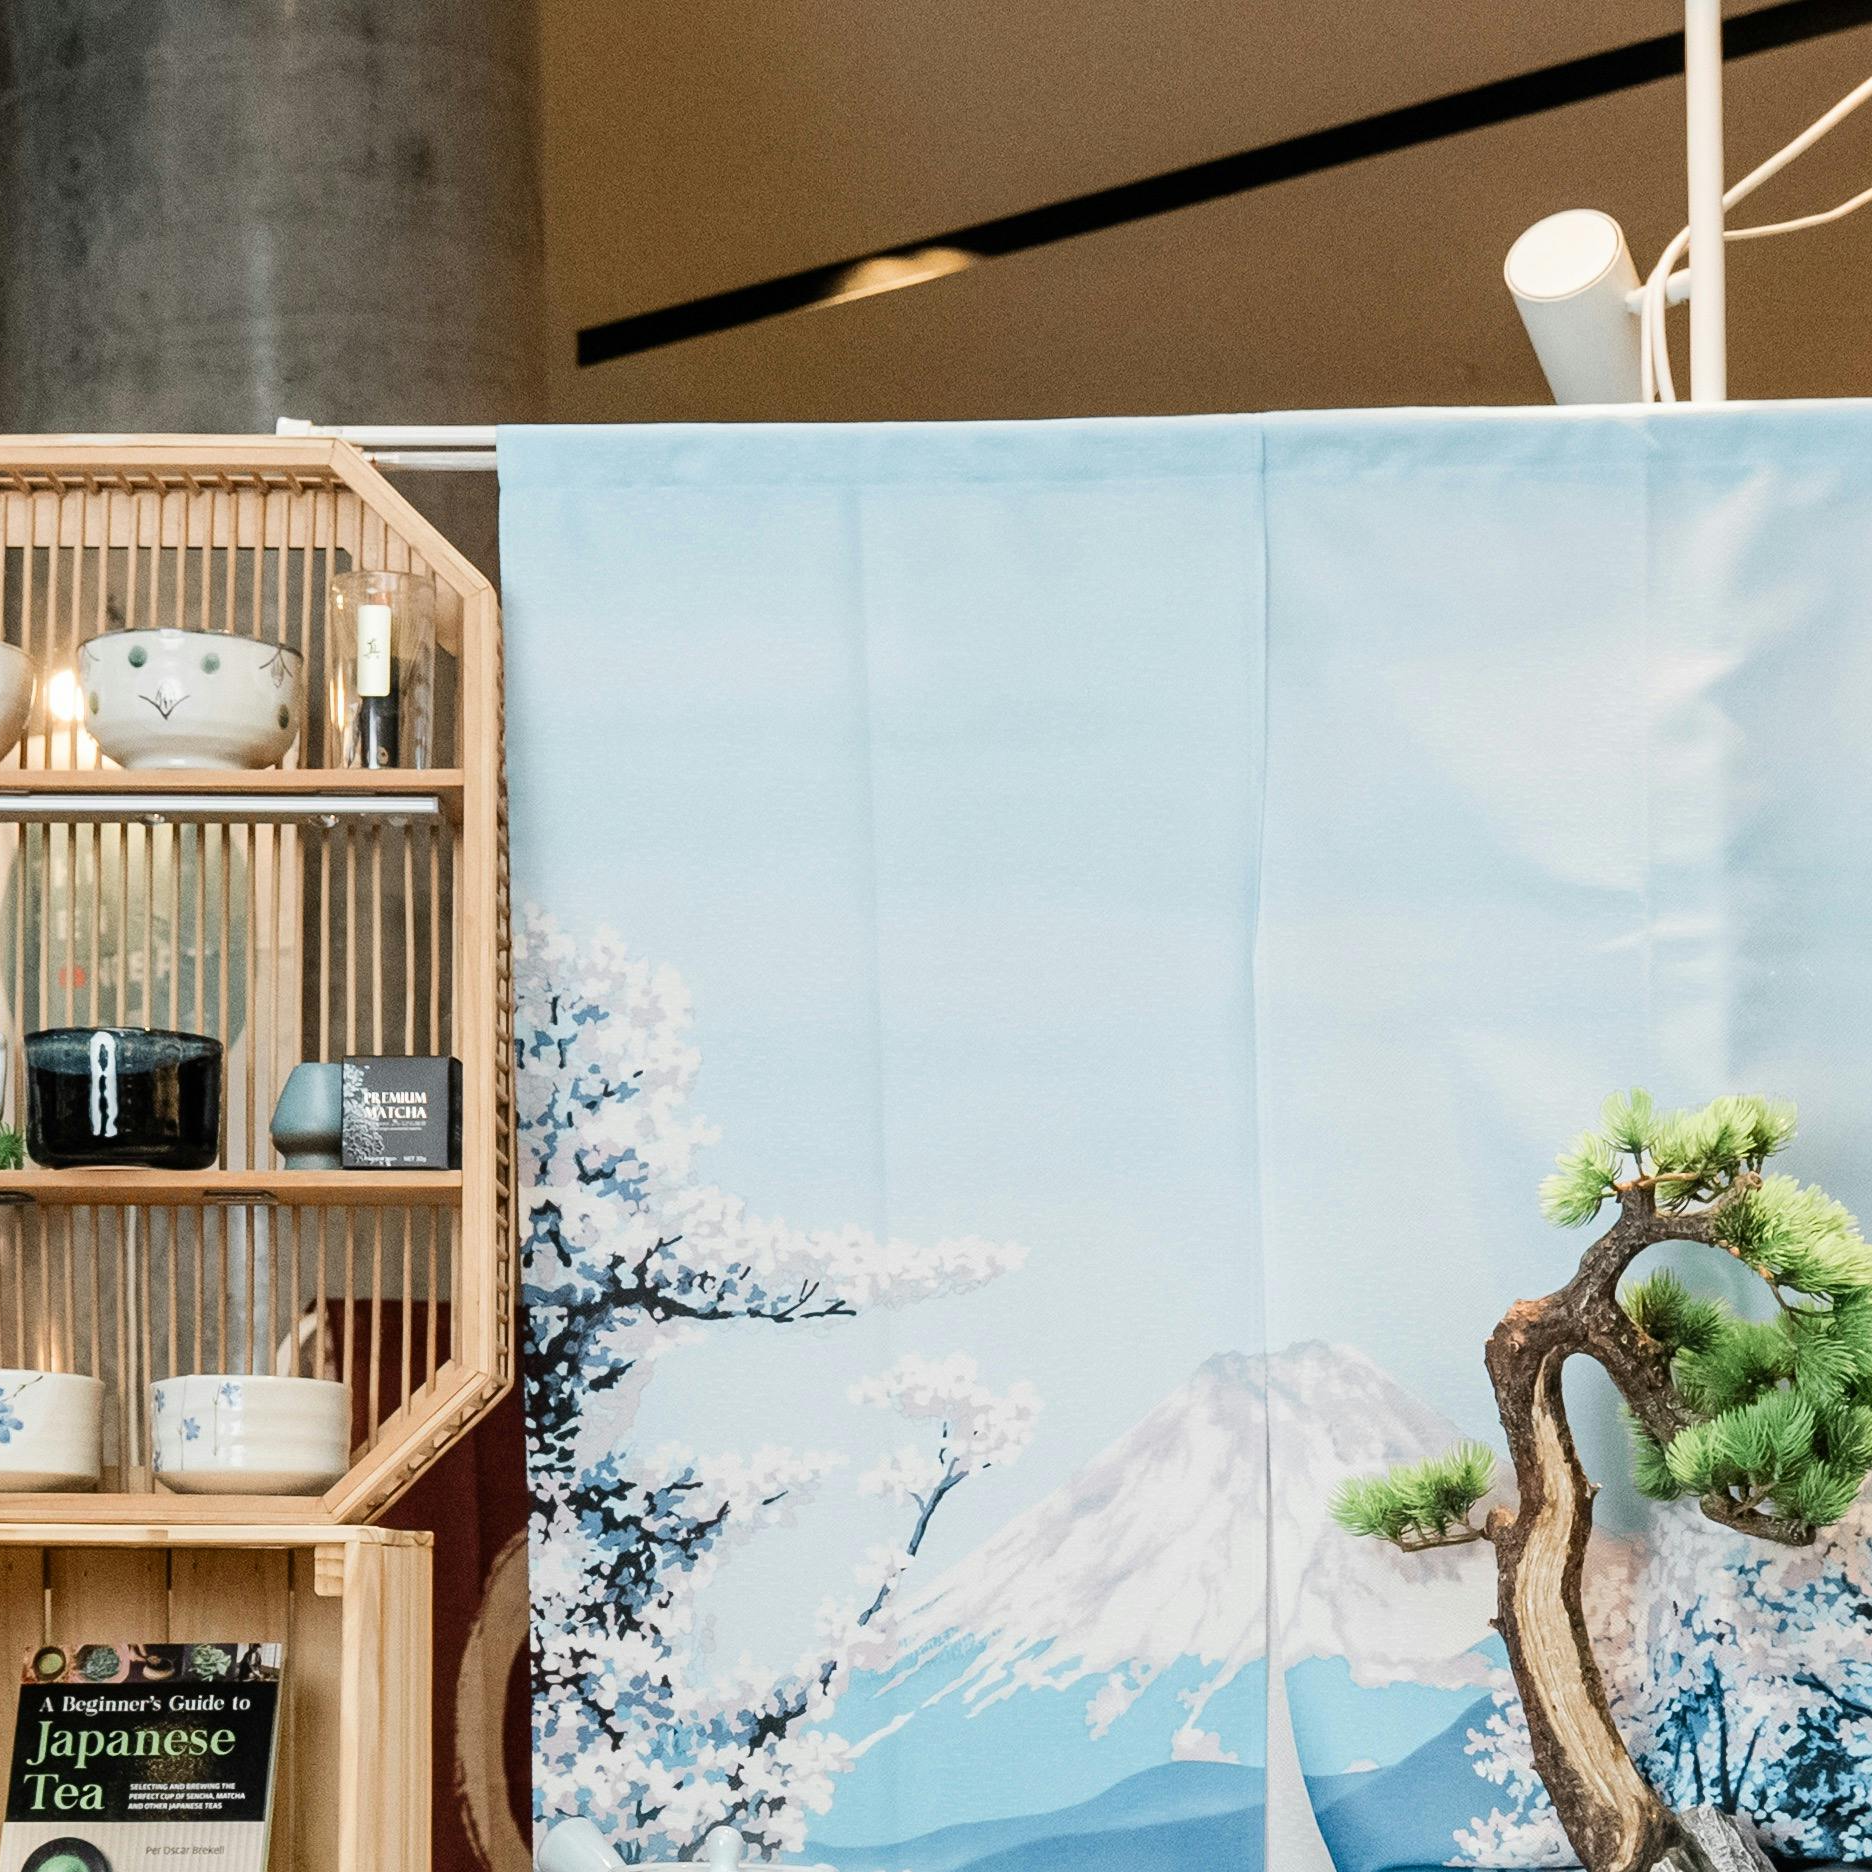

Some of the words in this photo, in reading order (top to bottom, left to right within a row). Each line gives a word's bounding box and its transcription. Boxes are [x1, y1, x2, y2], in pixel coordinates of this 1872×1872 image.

[364, 1091, 427, 1104] PREMIUM
[366, 1106, 427, 1119] MATCHA
[39, 1697, 54, 1712] A
[169, 1694, 225, 1711] Guide
[233, 1696, 251, 1711] to
[26, 1720, 237, 1769] Japanese
[24, 1773, 105, 1810] Tea
[130, 1783, 168, 1791] SELECTING
[216, 1792, 246, 1800] MATCHA
[169, 1802, 203, 1811] JAPANESE
[205, 1802, 223, 1810] TEAS
[146, 1846, 160, 1855] Per
[163, 1847, 189, 1855] Oscar
